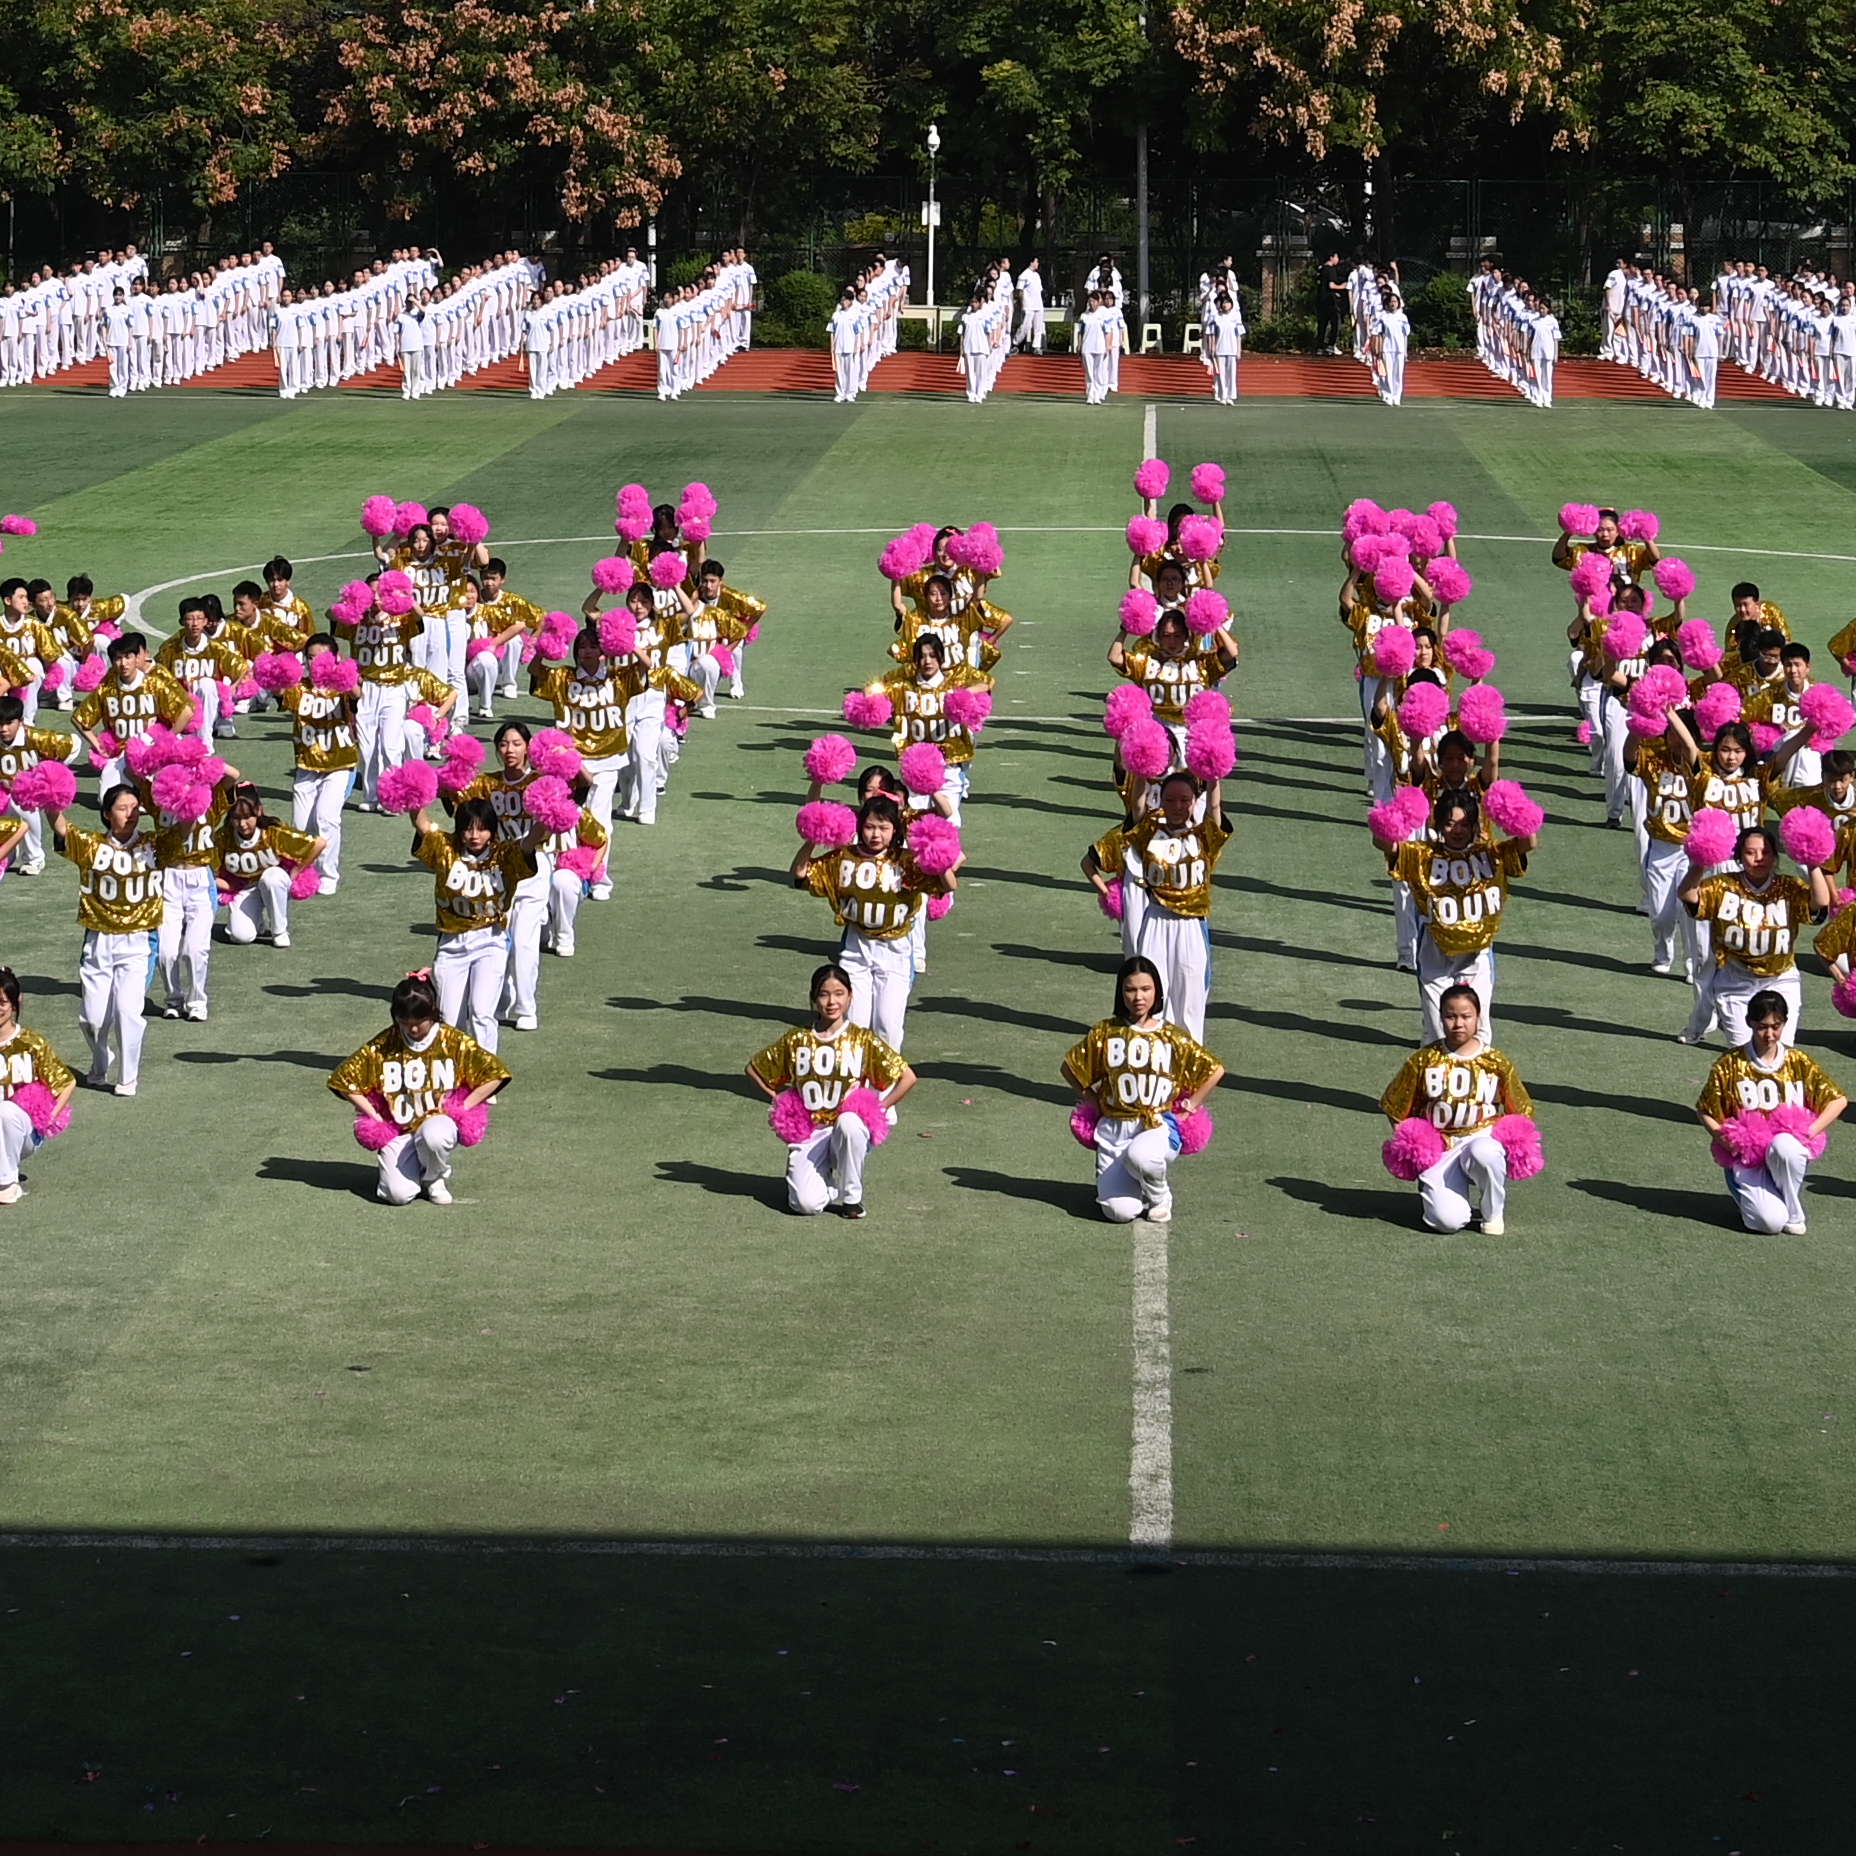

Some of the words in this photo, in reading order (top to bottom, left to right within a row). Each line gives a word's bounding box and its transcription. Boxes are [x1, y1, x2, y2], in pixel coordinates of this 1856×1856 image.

[174, 659, 215, 679] BON
[1145, 656, 1201, 683] BON
[106, 693, 155, 717] BON
[299, 693, 342, 721] BON
[567, 678, 615, 708] BON
[556, 705, 624, 732] JOUR
[1704, 777, 1760, 807] BON
[92, 844, 157, 876] BON
[225, 848, 281, 874] BON
[838, 859, 903, 893] BON
[1429, 851, 1493, 886] BON
[80, 870, 164, 904] JOUR
[445, 859, 506, 898] BON
[1718, 891, 1787, 927] BON
[795, 1045, 863, 1078] BON
[1107, 1037, 1172, 1073] BON
[383, 1058, 455, 1093] BON
[1425, 1067, 1498, 1103] BON
[1736, 1078, 1804, 1111] BON
